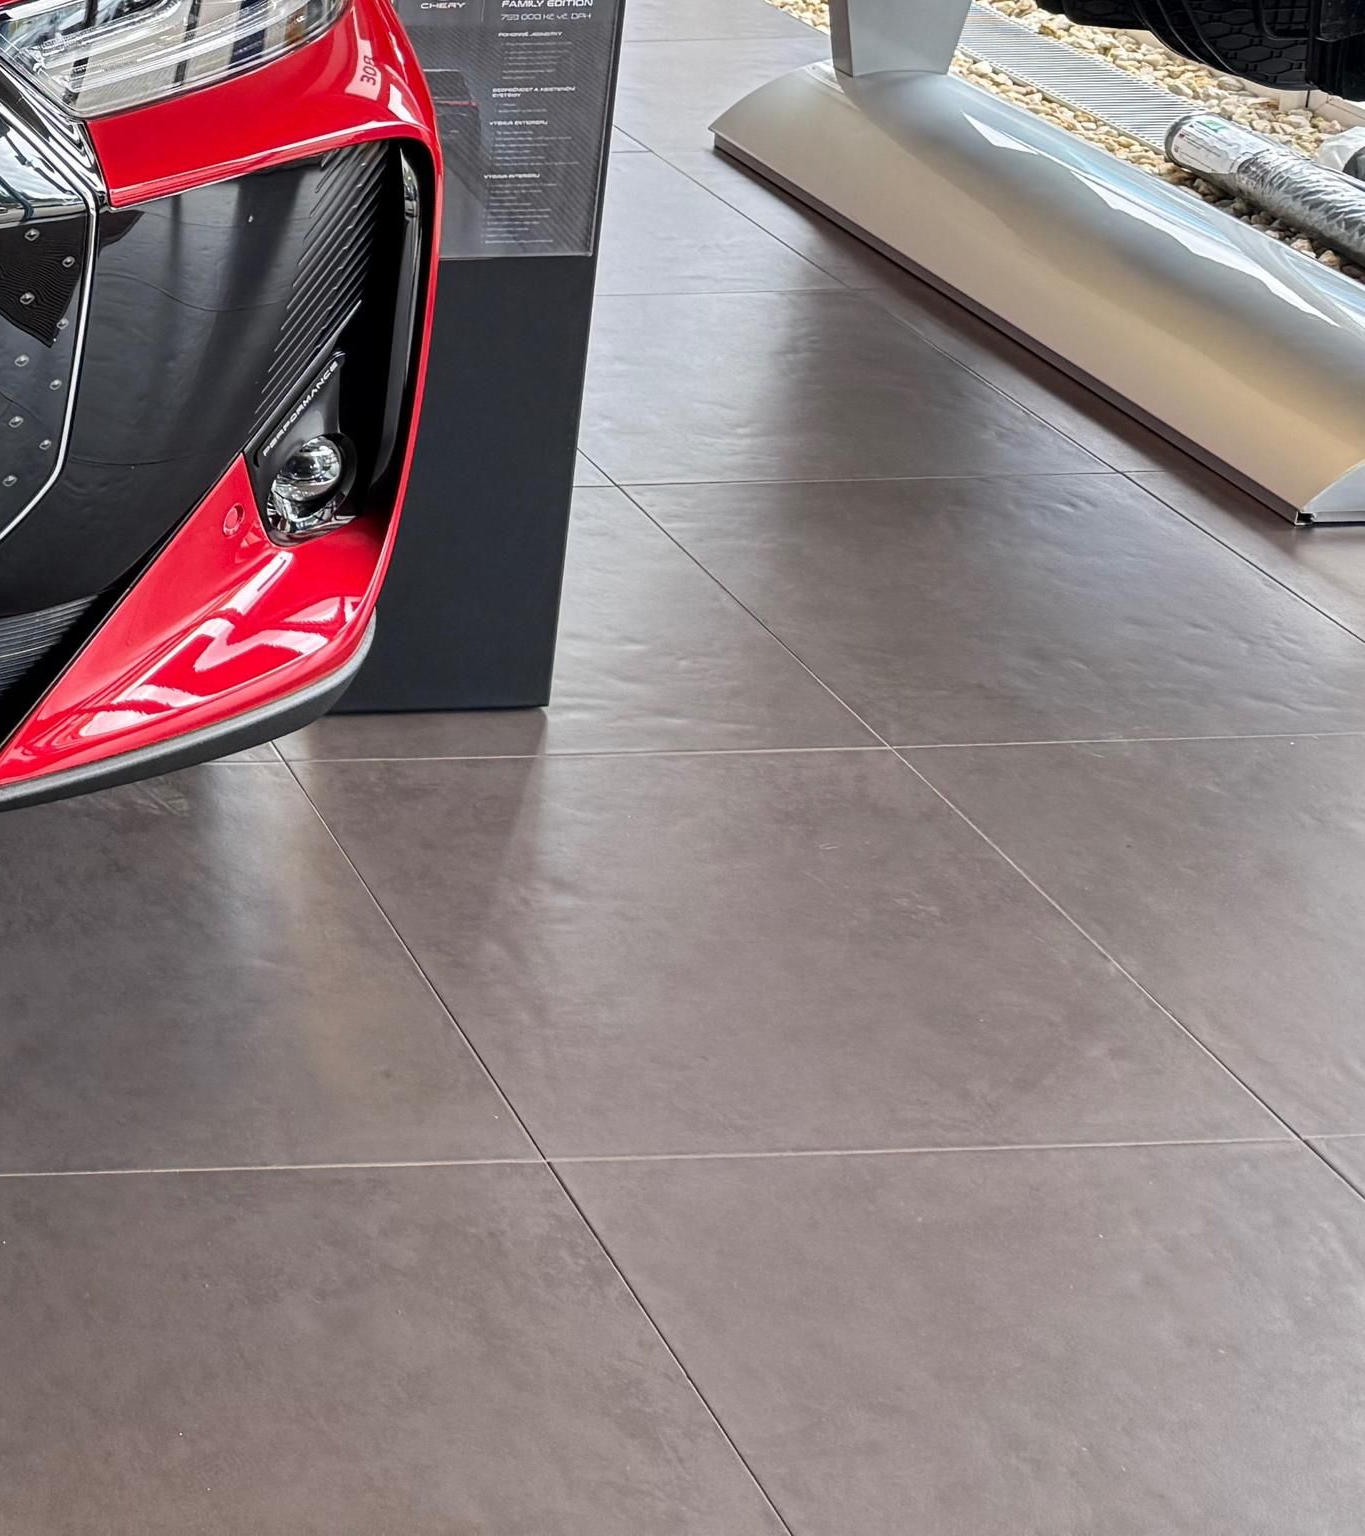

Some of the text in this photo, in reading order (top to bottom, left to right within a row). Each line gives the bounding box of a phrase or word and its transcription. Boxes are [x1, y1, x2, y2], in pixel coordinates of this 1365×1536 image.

[501, 0, 594, 8] FAMILY EDITION
[262, 360, 338, 456] PERFORMANCE
